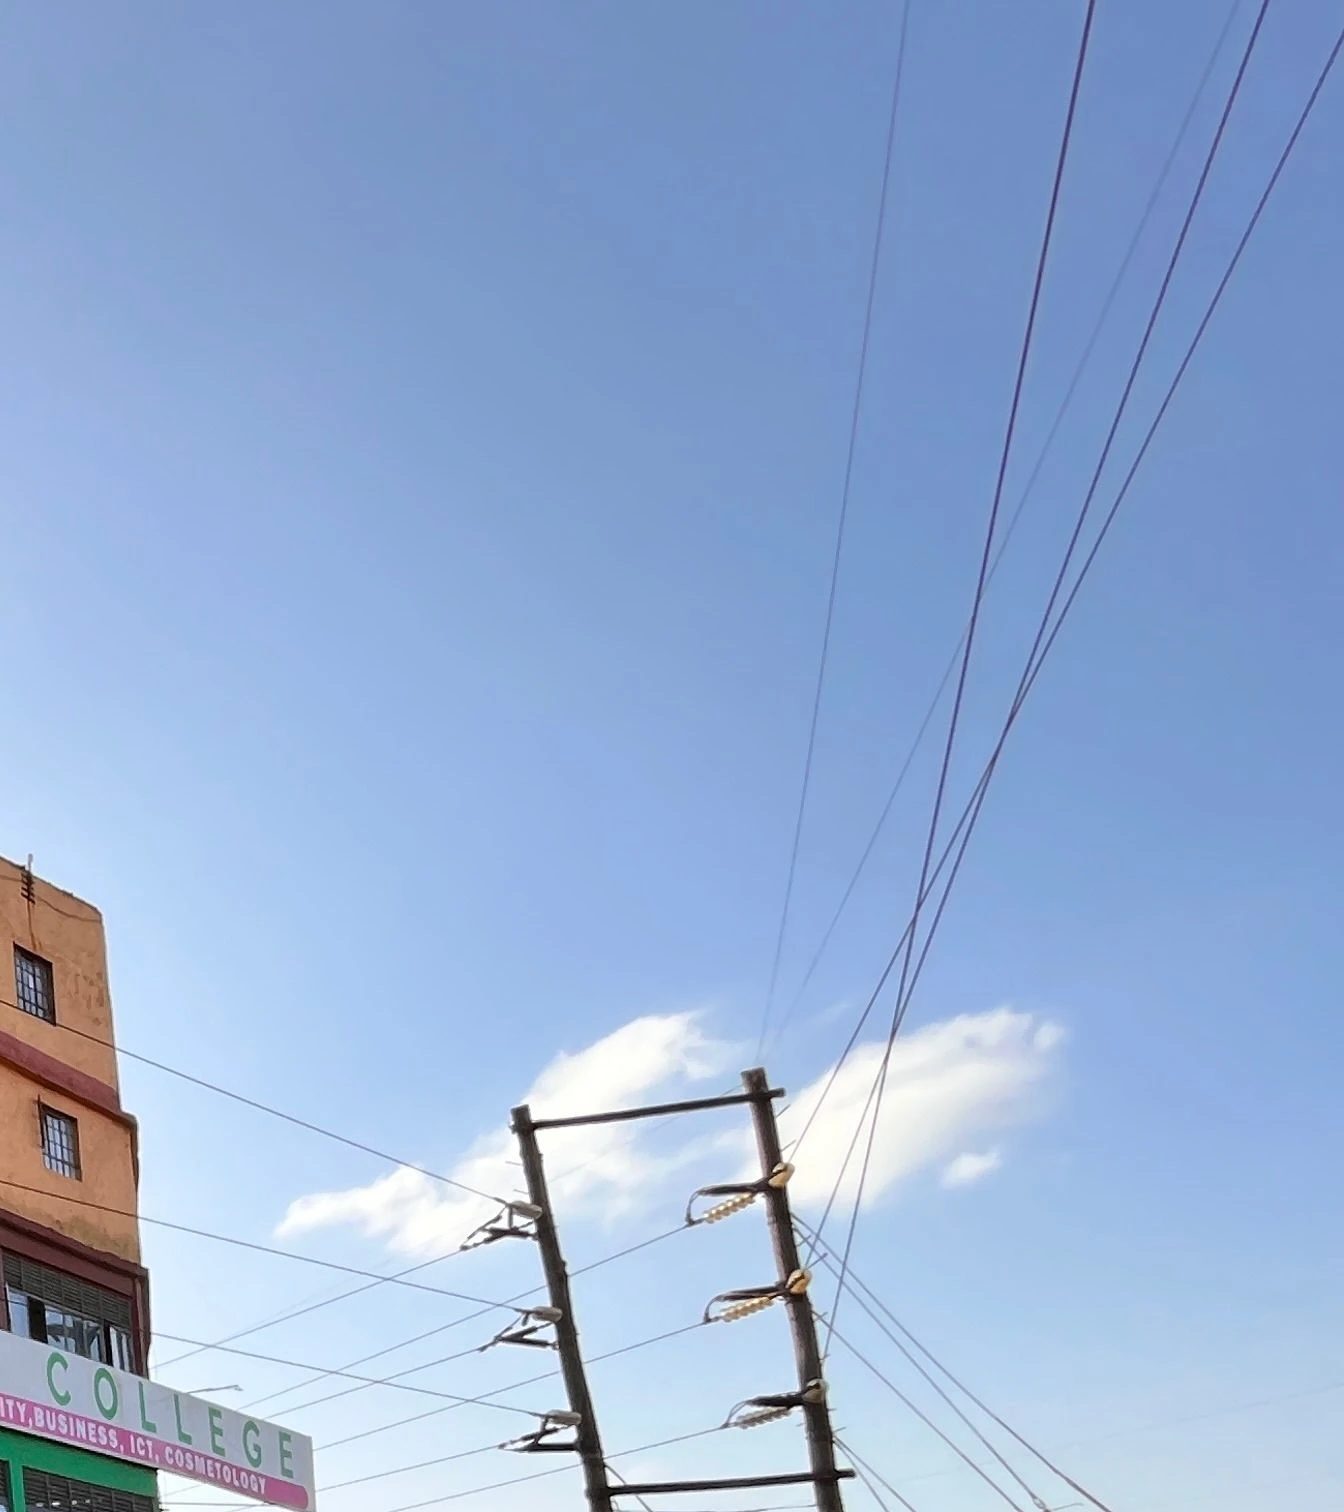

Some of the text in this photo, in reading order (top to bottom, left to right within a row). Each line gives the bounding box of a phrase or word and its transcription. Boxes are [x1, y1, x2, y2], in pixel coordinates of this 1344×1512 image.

[47, 1351, 294, 1479] COLLEGE
[130, 1436, 160, 1464] ICT,
[164, 1447, 267, 1494] COSMETOLOGY
